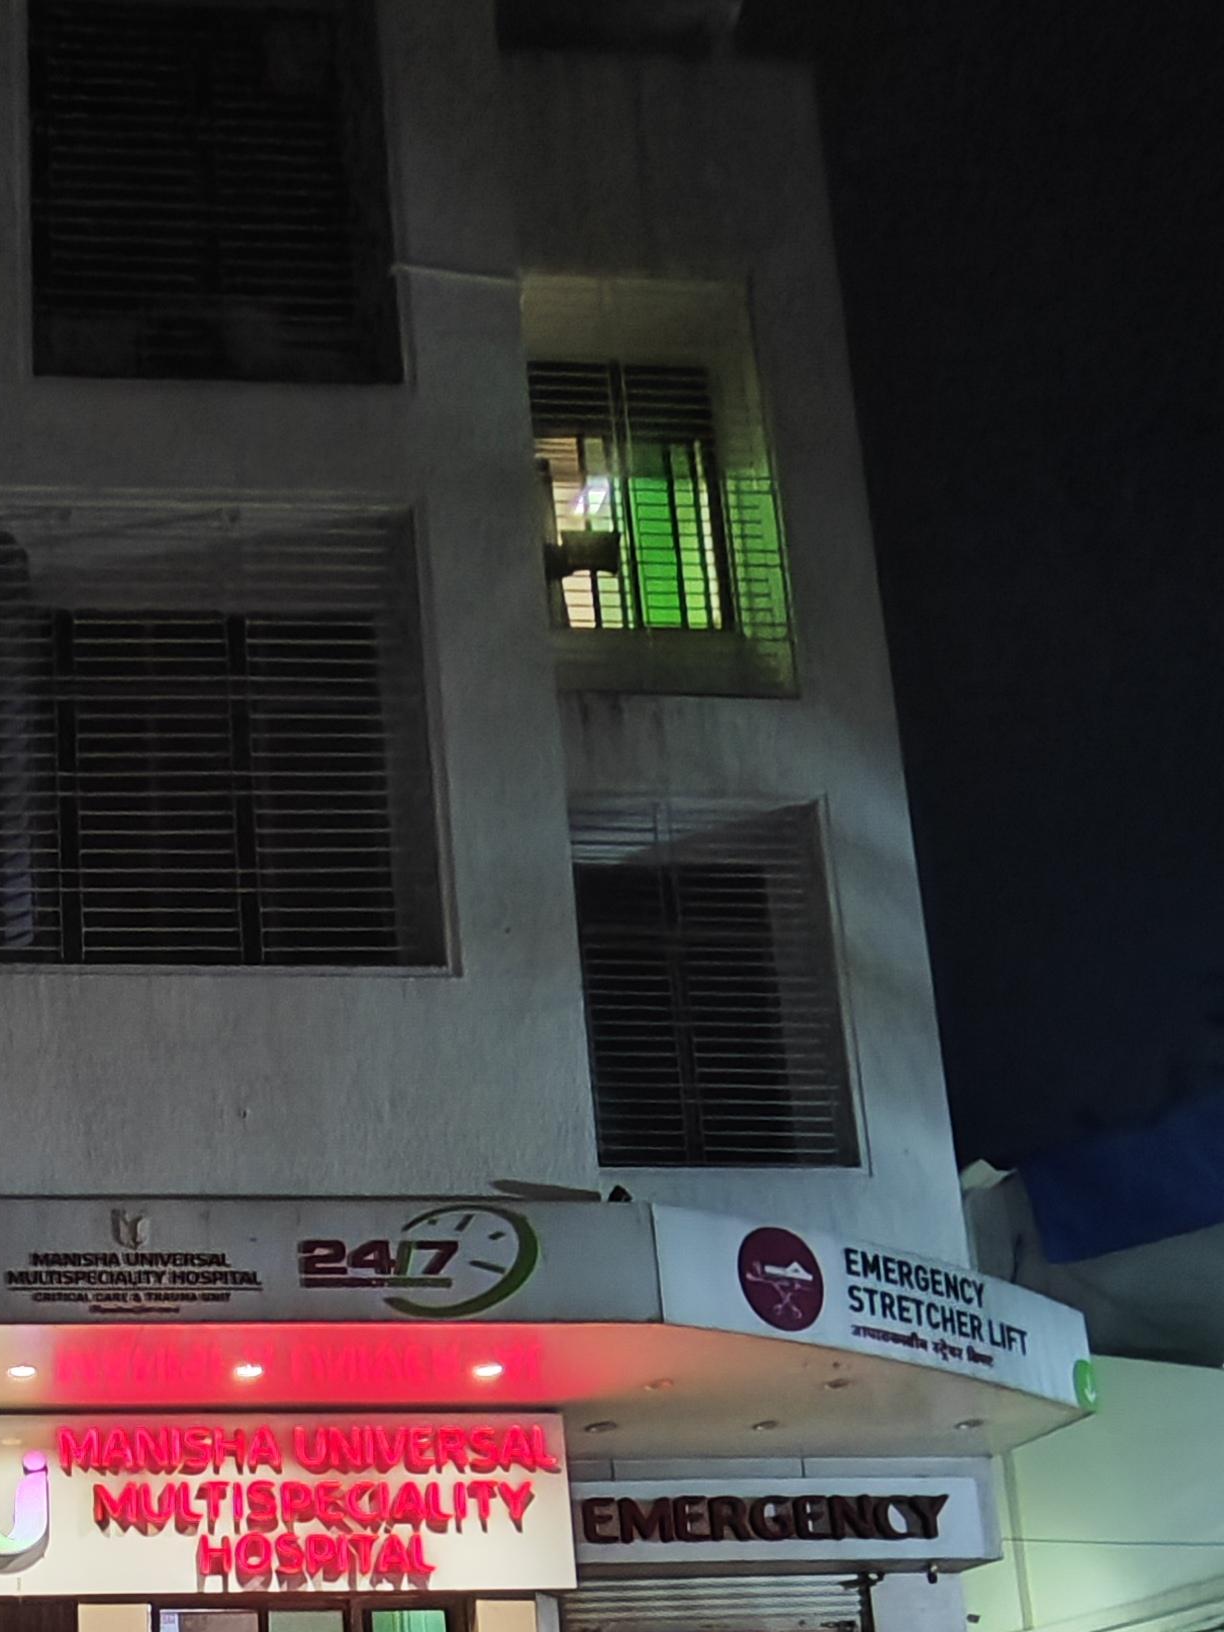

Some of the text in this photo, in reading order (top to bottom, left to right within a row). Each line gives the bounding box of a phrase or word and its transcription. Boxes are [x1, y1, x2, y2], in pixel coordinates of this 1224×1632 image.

[6, 1270, 262, 1286] MULTISPECIALITY HOSPITAL
[30, 1252, 231, 1267] MANISHA UNIVERSAL
[844, 1247, 984, 1308] EMERGENCY
[32, 1291, 92, 1302] CRITICAL
[848, 1285, 1027, 1356] STRETCHER LIFT
[56, 1423, 560, 1473] MANISHA UNIVERSAL
[93, 1480, 535, 1530] MULTISPECIALITY
[581, 1494, 949, 1543] EMERGENCY
[199, 1532, 436, 1579] HOSPITAL
